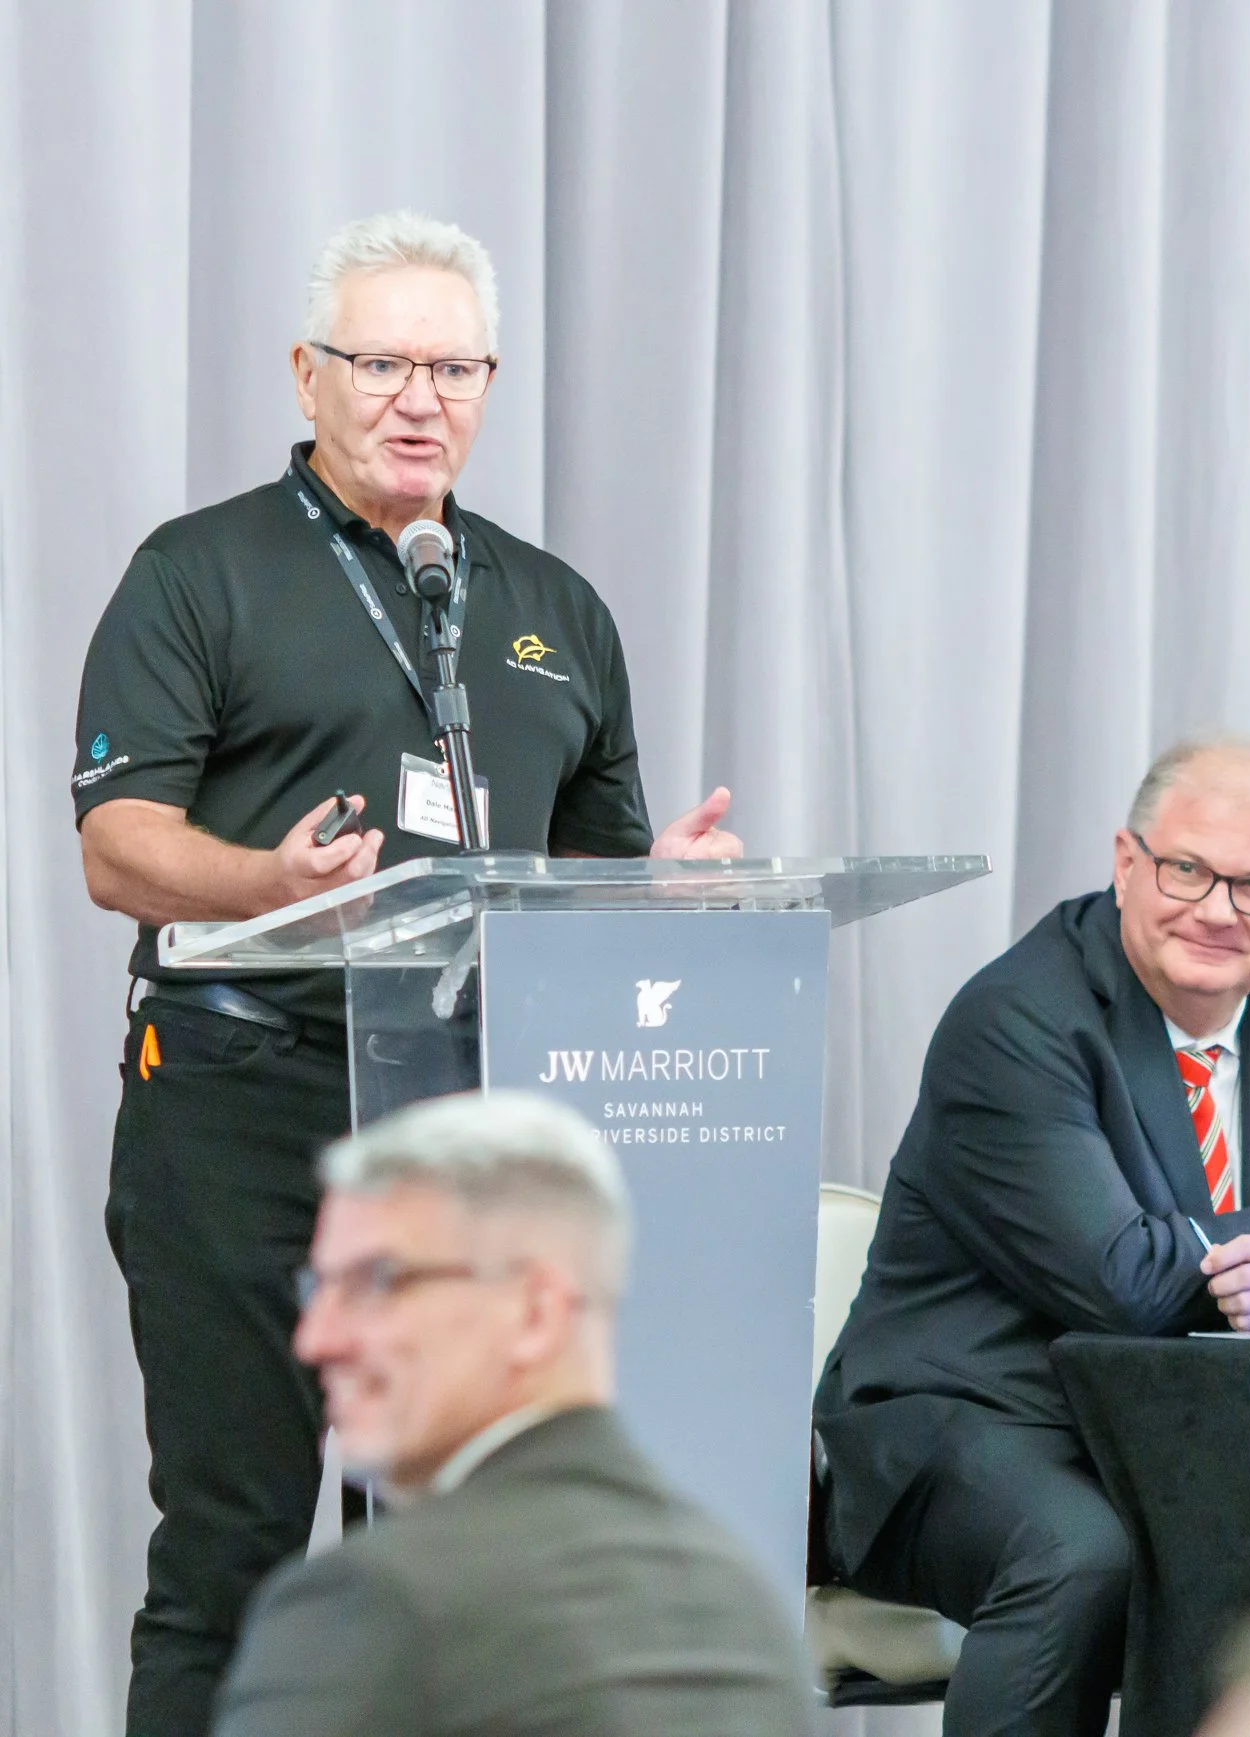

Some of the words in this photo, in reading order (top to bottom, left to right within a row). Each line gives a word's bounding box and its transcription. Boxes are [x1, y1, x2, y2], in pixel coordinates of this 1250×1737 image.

[539, 1051, 594, 1083] JW
[602, 1049, 770, 1081] MARRIOTT
[604, 1103, 703, 1118] SAVANNAH
[699, 1126, 786, 1143] DISTRICT
